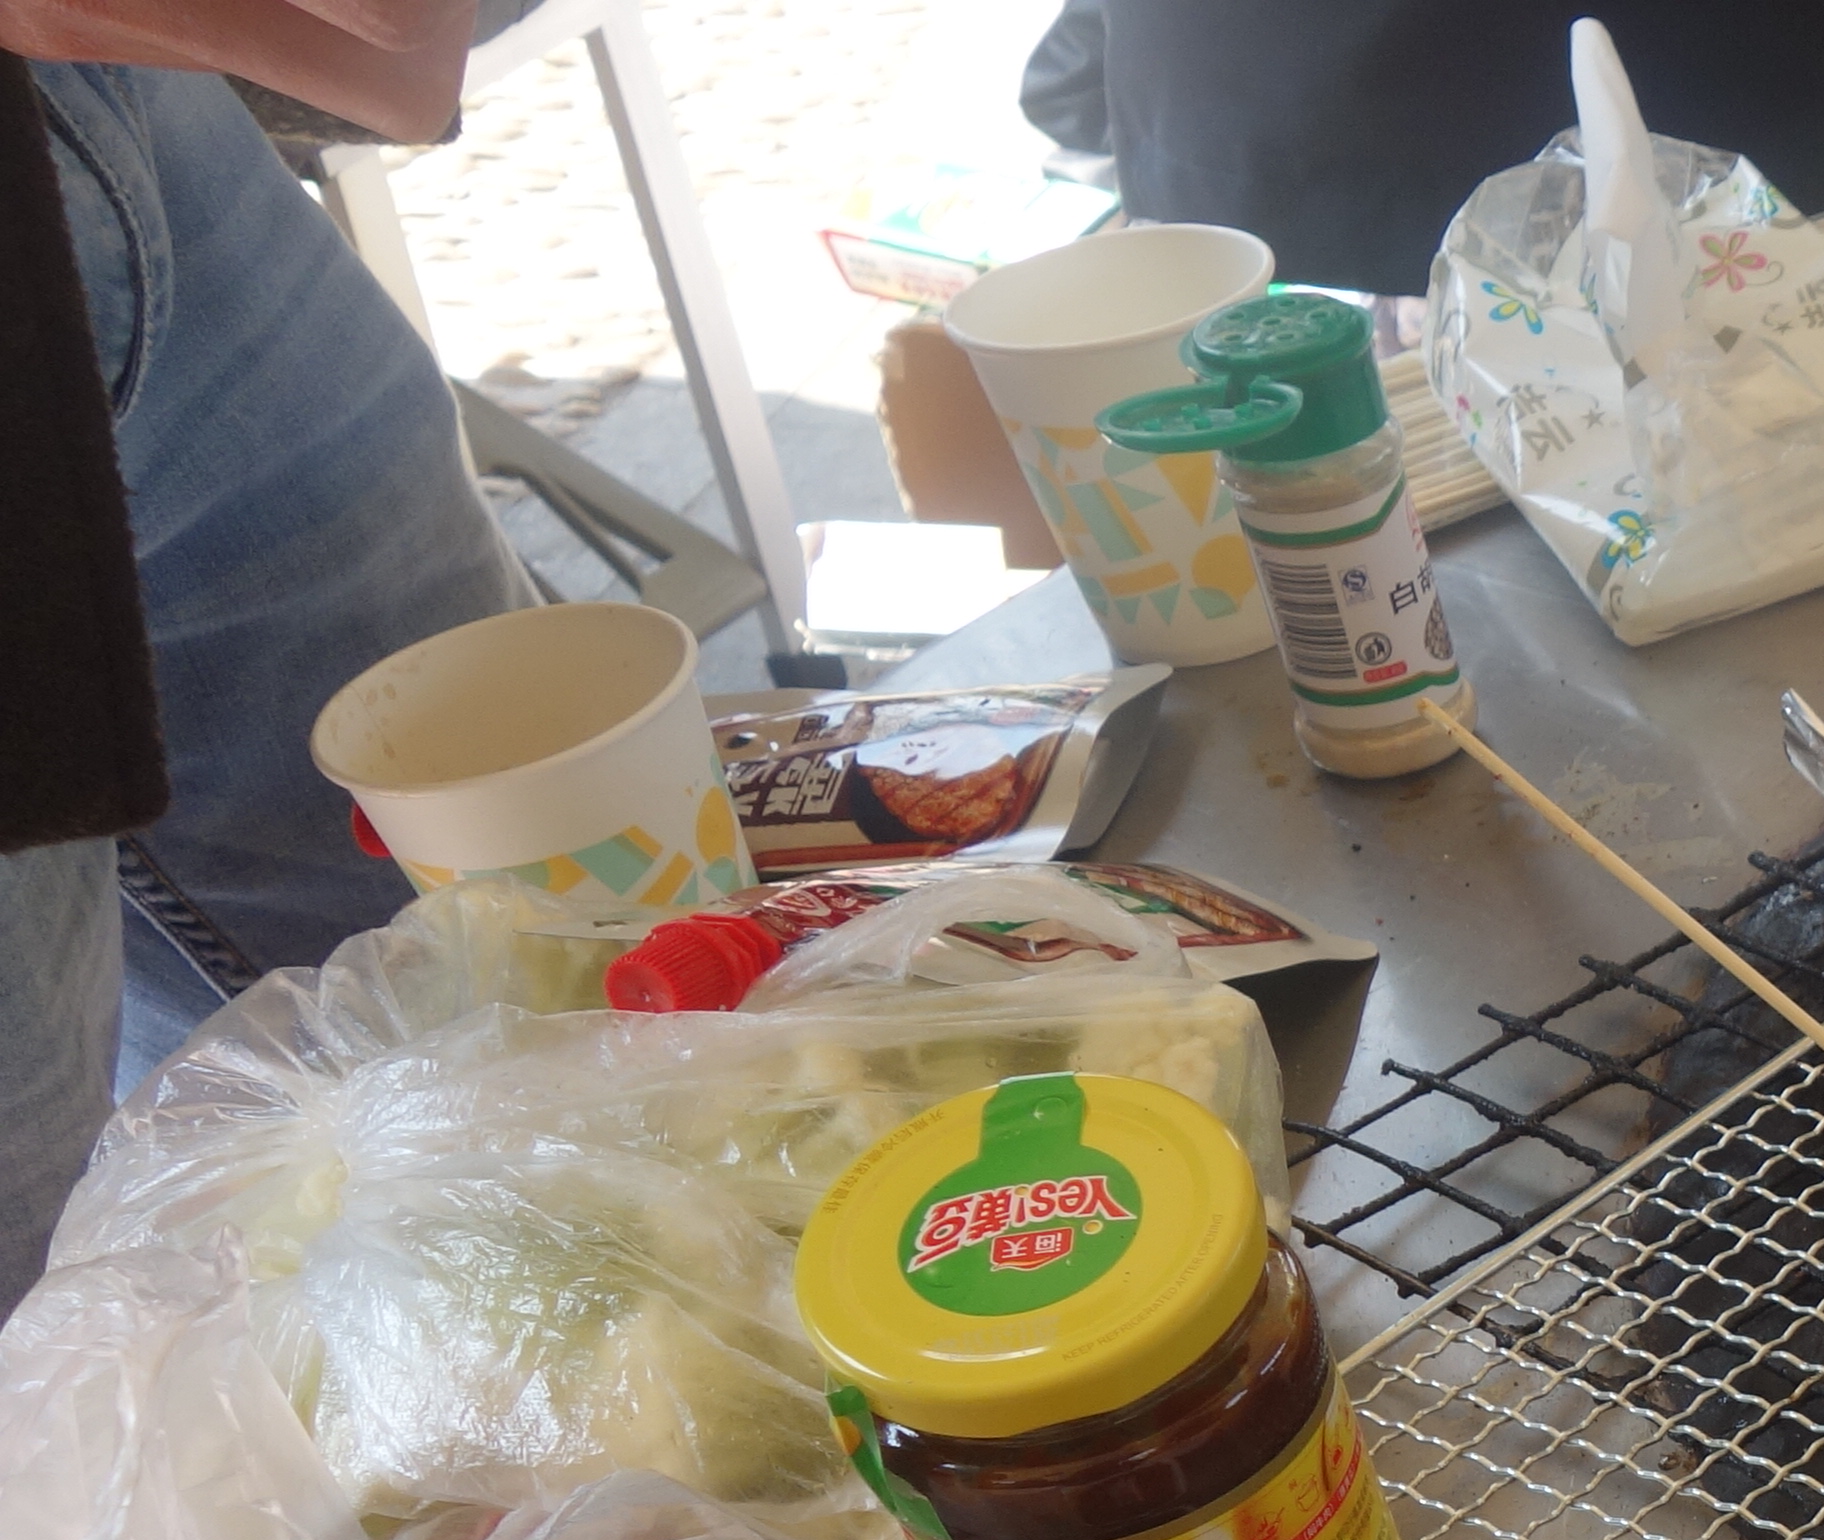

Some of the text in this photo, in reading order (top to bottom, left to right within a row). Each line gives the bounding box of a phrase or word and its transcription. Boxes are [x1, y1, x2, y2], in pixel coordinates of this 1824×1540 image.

[1001, 1229, 1064, 1260] 海天
[1061, 1341, 1095, 1361] KEEP
[1097, 1286, 1178, 1346] REFRIGERATED
